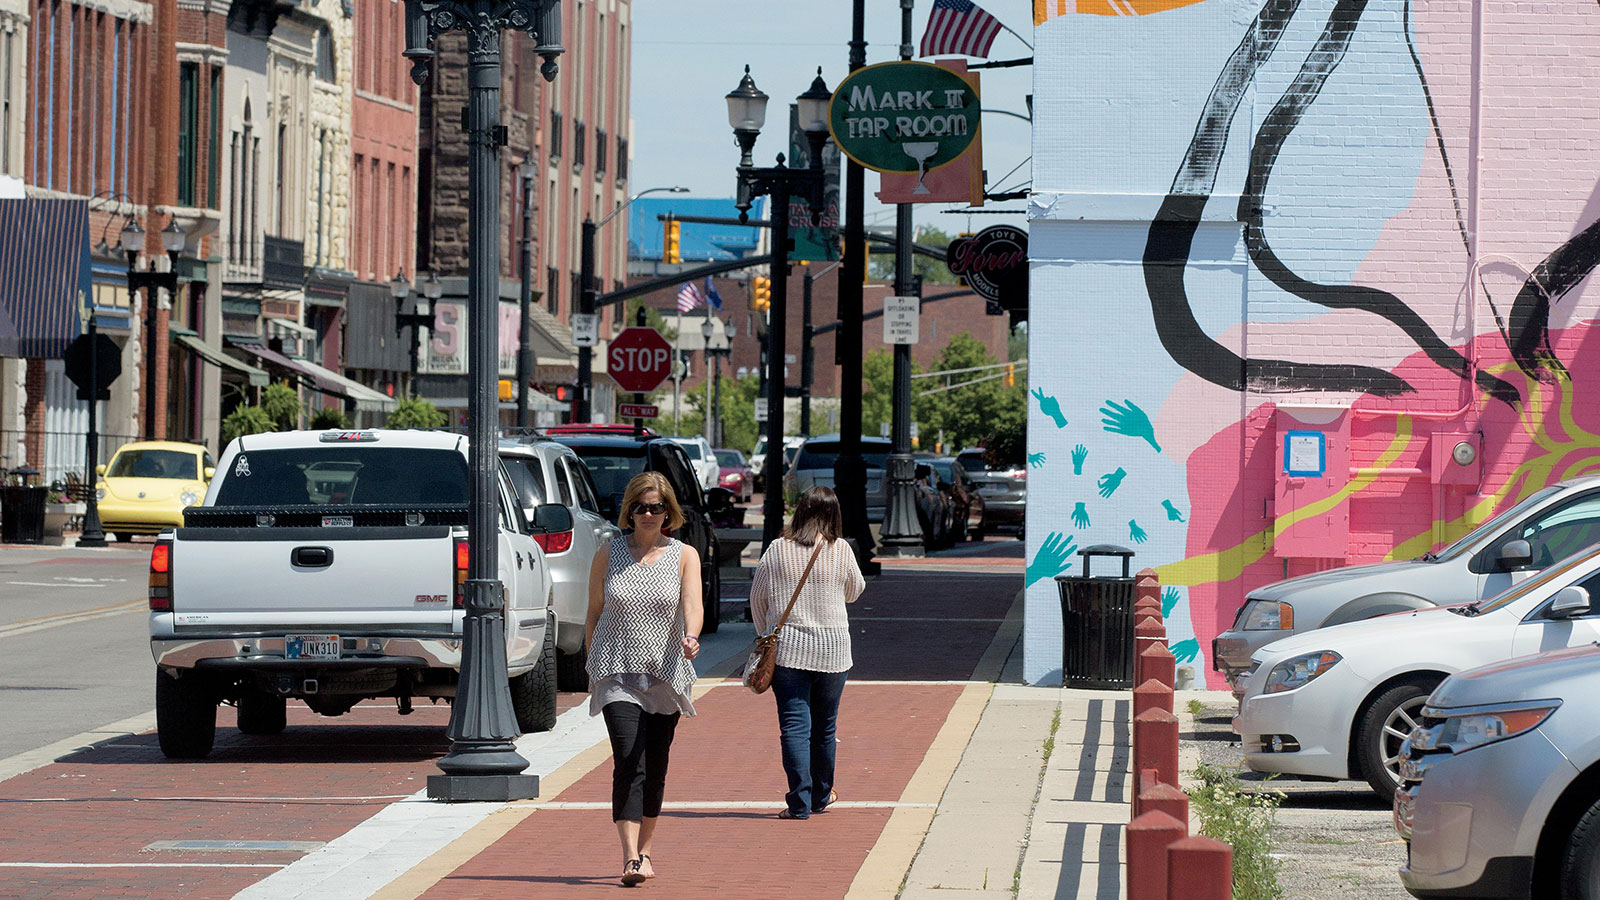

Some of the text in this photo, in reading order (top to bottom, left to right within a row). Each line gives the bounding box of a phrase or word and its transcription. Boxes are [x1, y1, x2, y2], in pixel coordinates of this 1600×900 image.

[845, 114, 967, 138] TAP ROOM
[990, 230, 1016, 240] TOYS
[972, 273, 1000, 297] MODELS
[433, 302, 458, 355] S
[611, 347, 668, 372] STOP
[416, 594, 448, 602] GMC
[303, 642, 338, 655] UNK310
